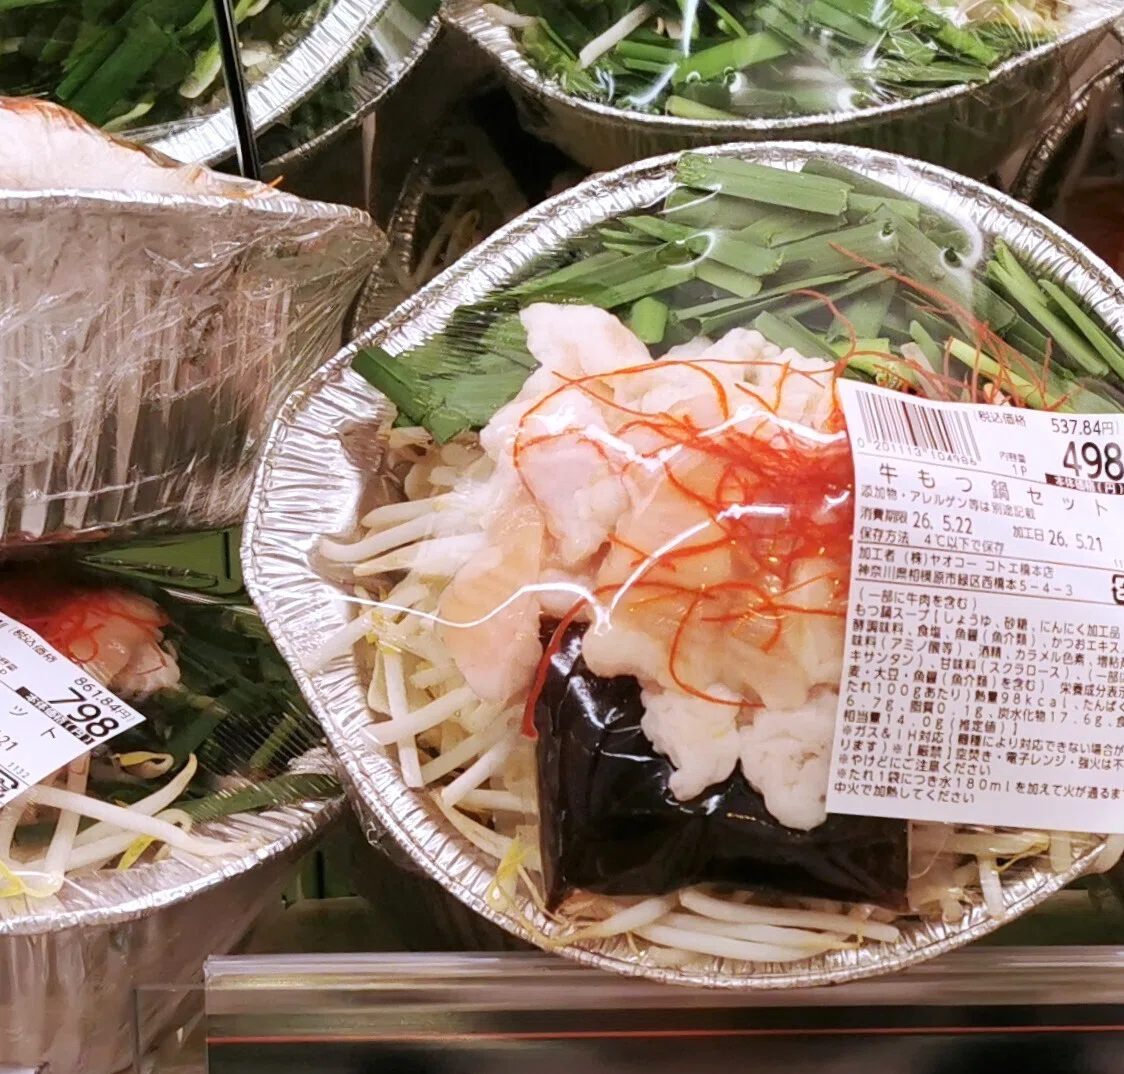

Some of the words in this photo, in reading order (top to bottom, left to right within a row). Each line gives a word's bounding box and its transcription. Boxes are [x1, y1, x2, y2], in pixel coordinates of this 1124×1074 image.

[1062, 438, 1124, 480] 498
[860, 506, 907, 524] 消費期限
[1013, 526, 1044, 541] 加工日
[860, 526, 908, 543] 保存方法
[858, 546, 894, 561] 加工者
[49, 686, 120, 738] 798
